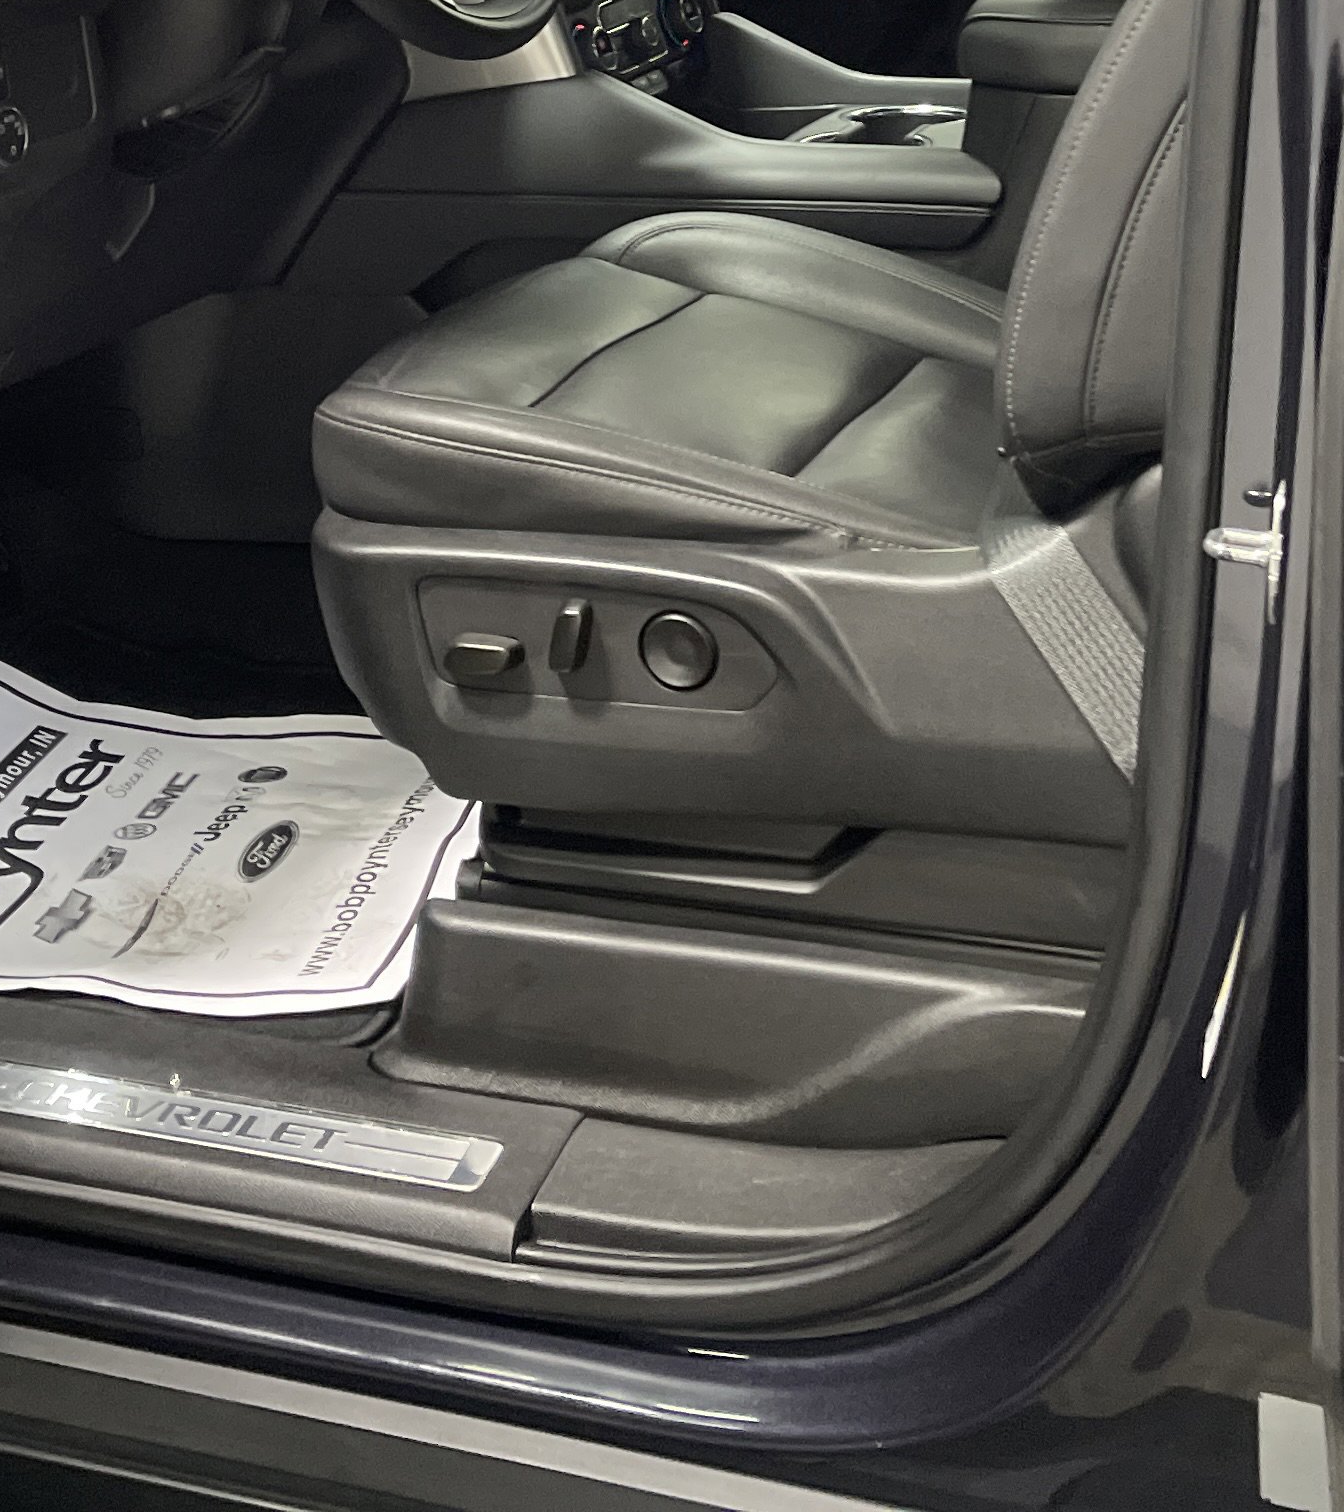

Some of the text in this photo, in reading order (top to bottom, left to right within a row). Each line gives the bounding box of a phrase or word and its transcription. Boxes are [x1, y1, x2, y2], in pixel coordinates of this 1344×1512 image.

[29, 729, 56, 750] IN
[135, 771, 200, 819] GMC
[193, 804, 248, 842] Jeep
[247, 832, 287, 869] Ford
[16, 1079, 348, 1153] CHEVROLET
